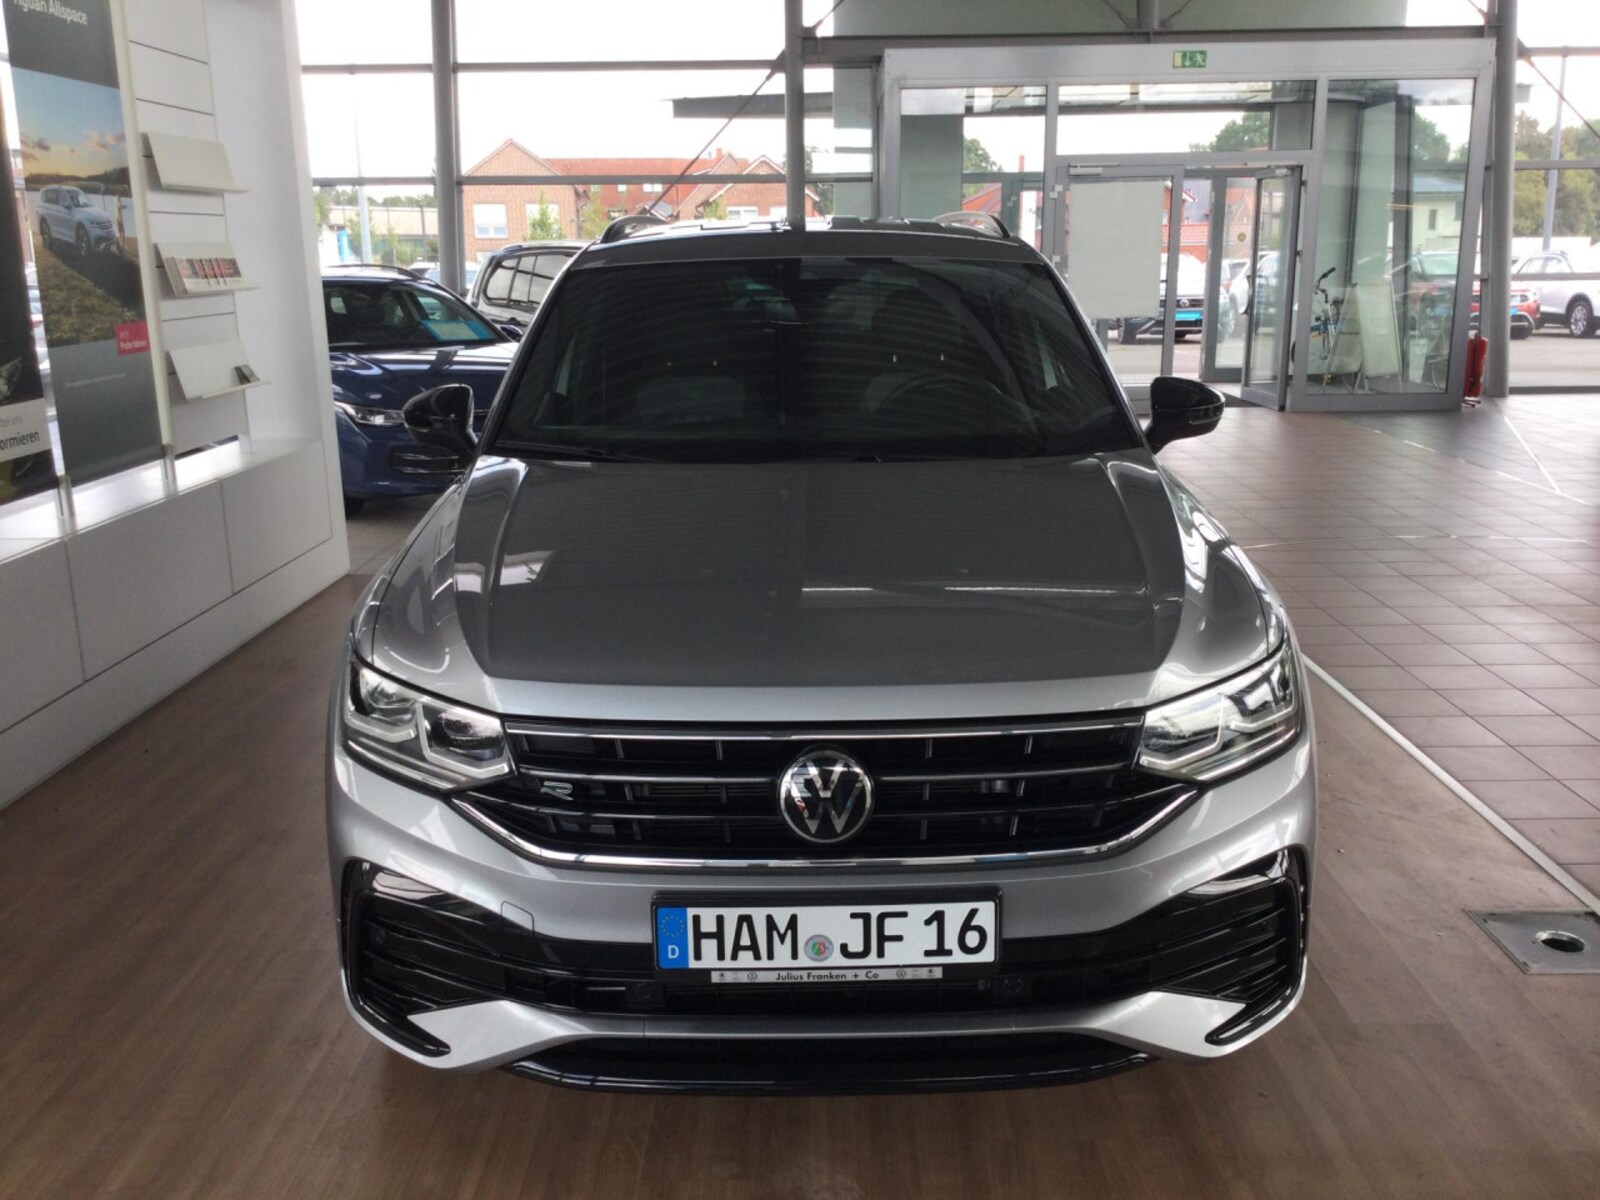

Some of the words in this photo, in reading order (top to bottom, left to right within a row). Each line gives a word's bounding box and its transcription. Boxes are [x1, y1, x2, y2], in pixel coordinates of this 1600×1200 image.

[49, 0, 88, 25] Allspace
[692, 913, 798, 961] HAM
[840, 911, 909, 960] JF
[923, 907, 988, 957] 16
[667, 944, 680, 959] D
[775, 972, 804, 981] Julius
[806, 971, 847, 981] Franken
[852, 972, 860, 980] +
[865, 970, 879, 980] Co
